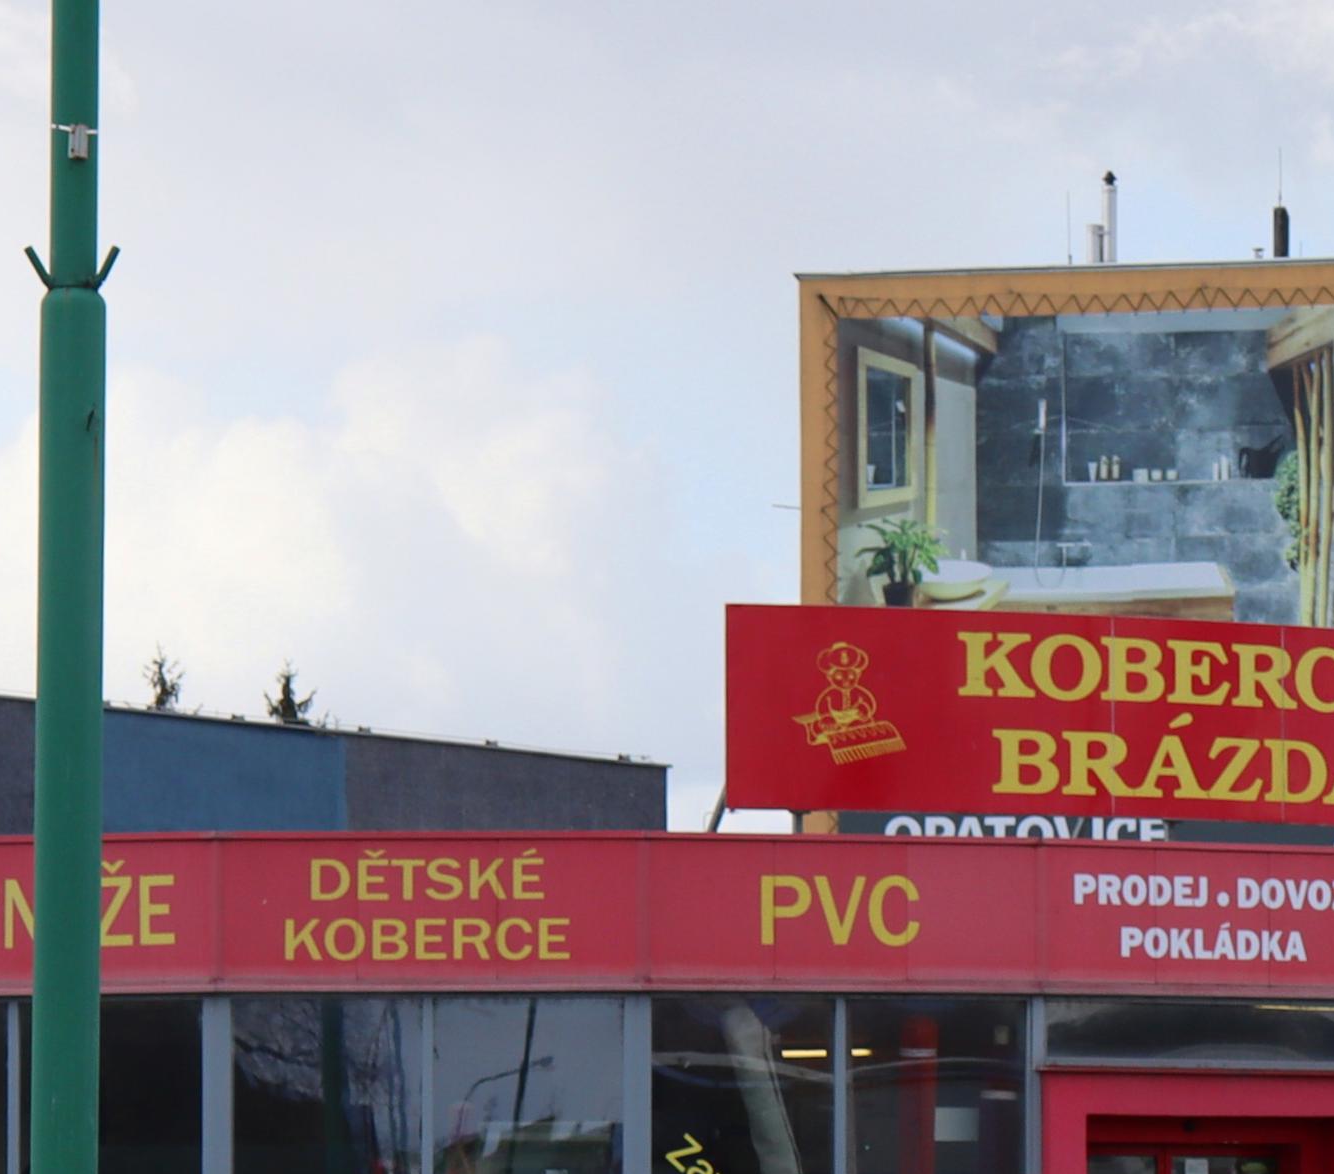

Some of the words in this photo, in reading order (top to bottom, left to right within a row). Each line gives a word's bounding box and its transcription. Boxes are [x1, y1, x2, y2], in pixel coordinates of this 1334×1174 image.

[310, 848, 545, 901] DĚTSKÉ
[1073, 873, 1208, 908] PRODEJ
[761, 874, 920, 947] PVC
[284, 917, 571, 961] KOBERCE
[1120, 922, 1308, 962] POKLÁDKA
